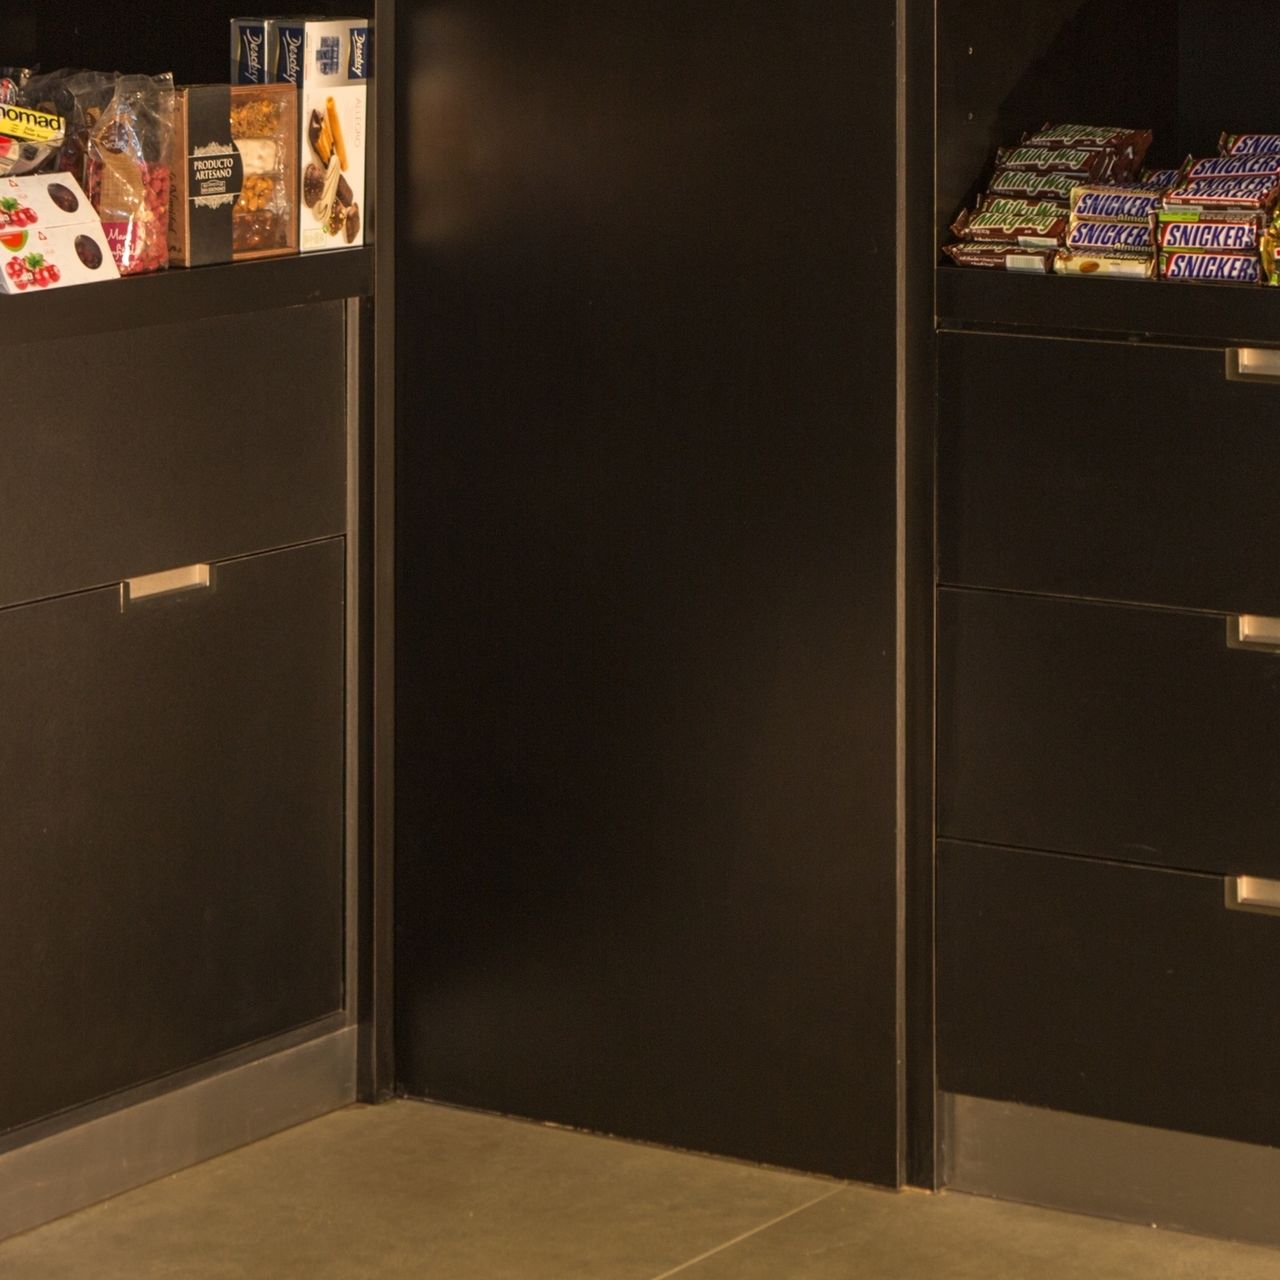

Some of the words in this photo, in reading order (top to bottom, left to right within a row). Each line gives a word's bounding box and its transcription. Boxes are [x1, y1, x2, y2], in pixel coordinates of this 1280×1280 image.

[350, 30, 366, 77] Desobry
[193, 157, 234, 170] PRODUCTO
[1006, 147, 1052, 169] Milky
[195, 168, 232, 180] ARTESANO
[994, 171, 1043, 197] Milky
[1167, 224, 1255, 248] SNICKERS
